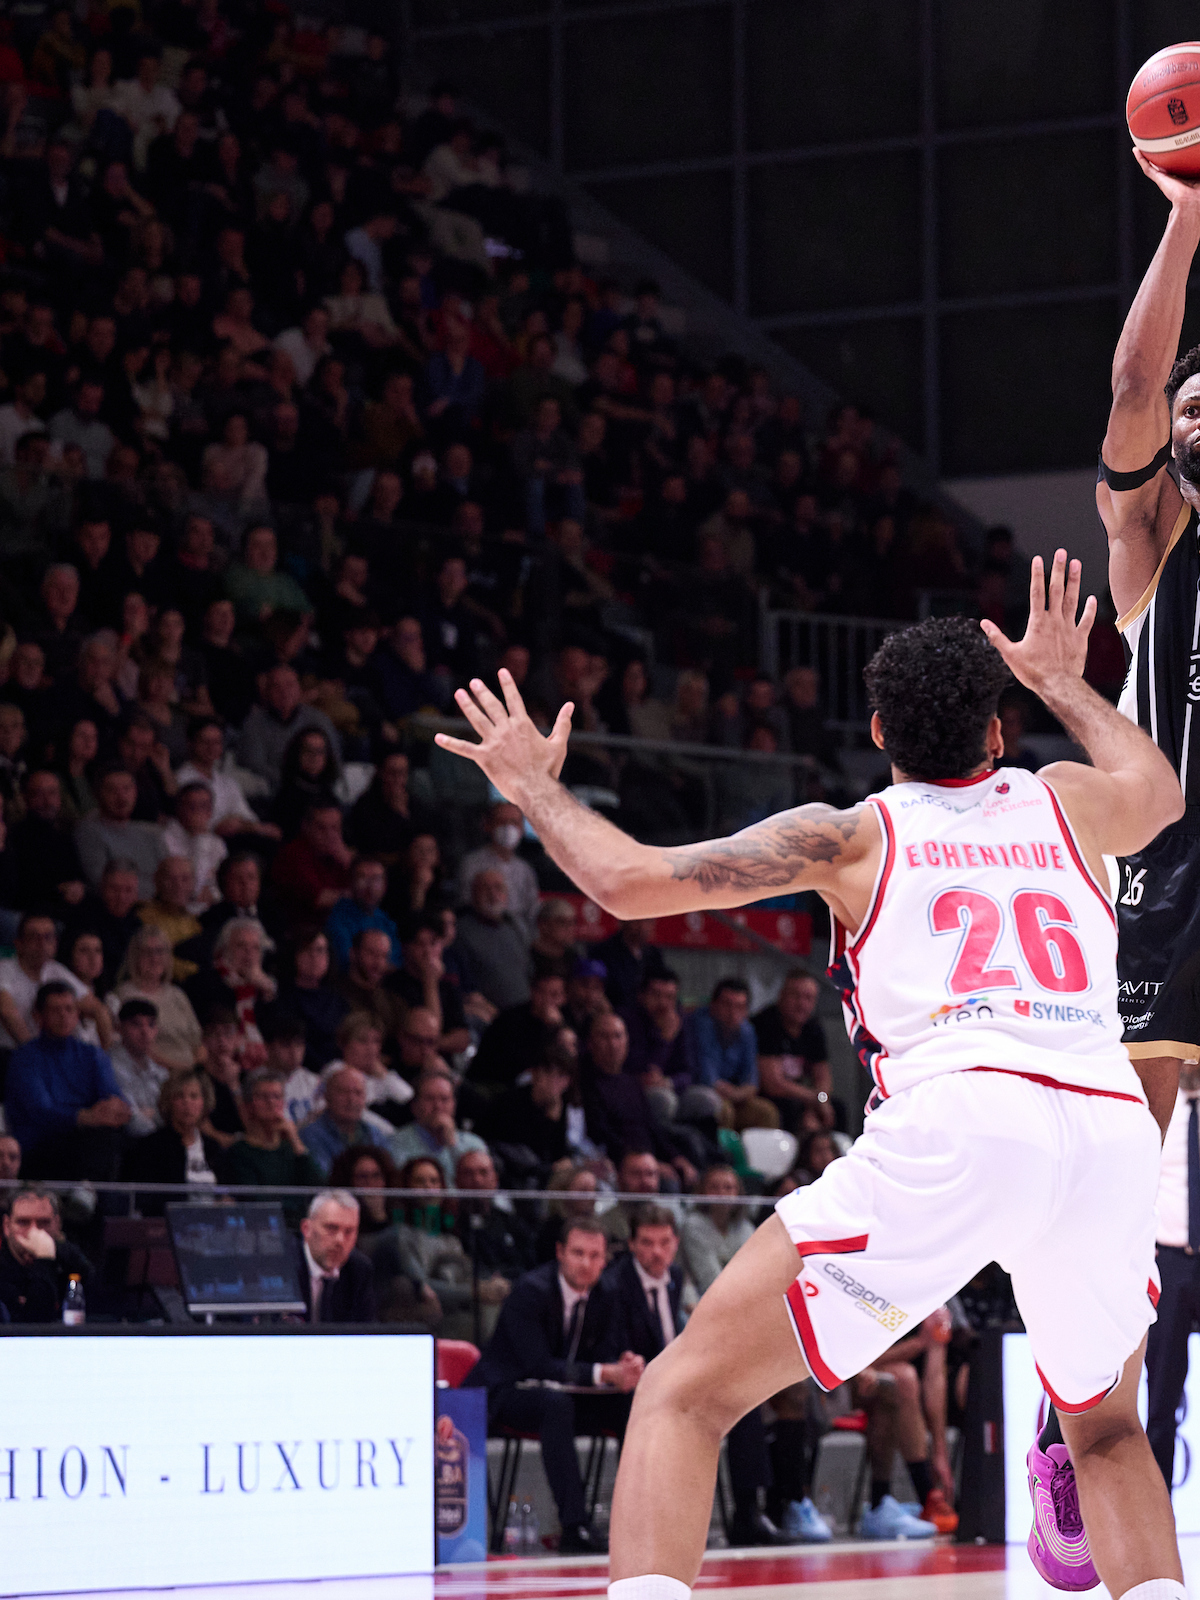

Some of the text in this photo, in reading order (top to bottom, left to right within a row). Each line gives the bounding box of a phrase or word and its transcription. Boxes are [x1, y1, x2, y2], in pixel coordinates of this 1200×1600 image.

[904, 839, 1068, 872] ECHENIQUE
[1119, 864, 1148, 907] 26
[928, 885, 1093, 997] 26
[1117, 980, 1165, 996] AVIT
[1032, 1001, 1107, 1030] SYNER
[198, 1436, 417, 1496] LUXURY
